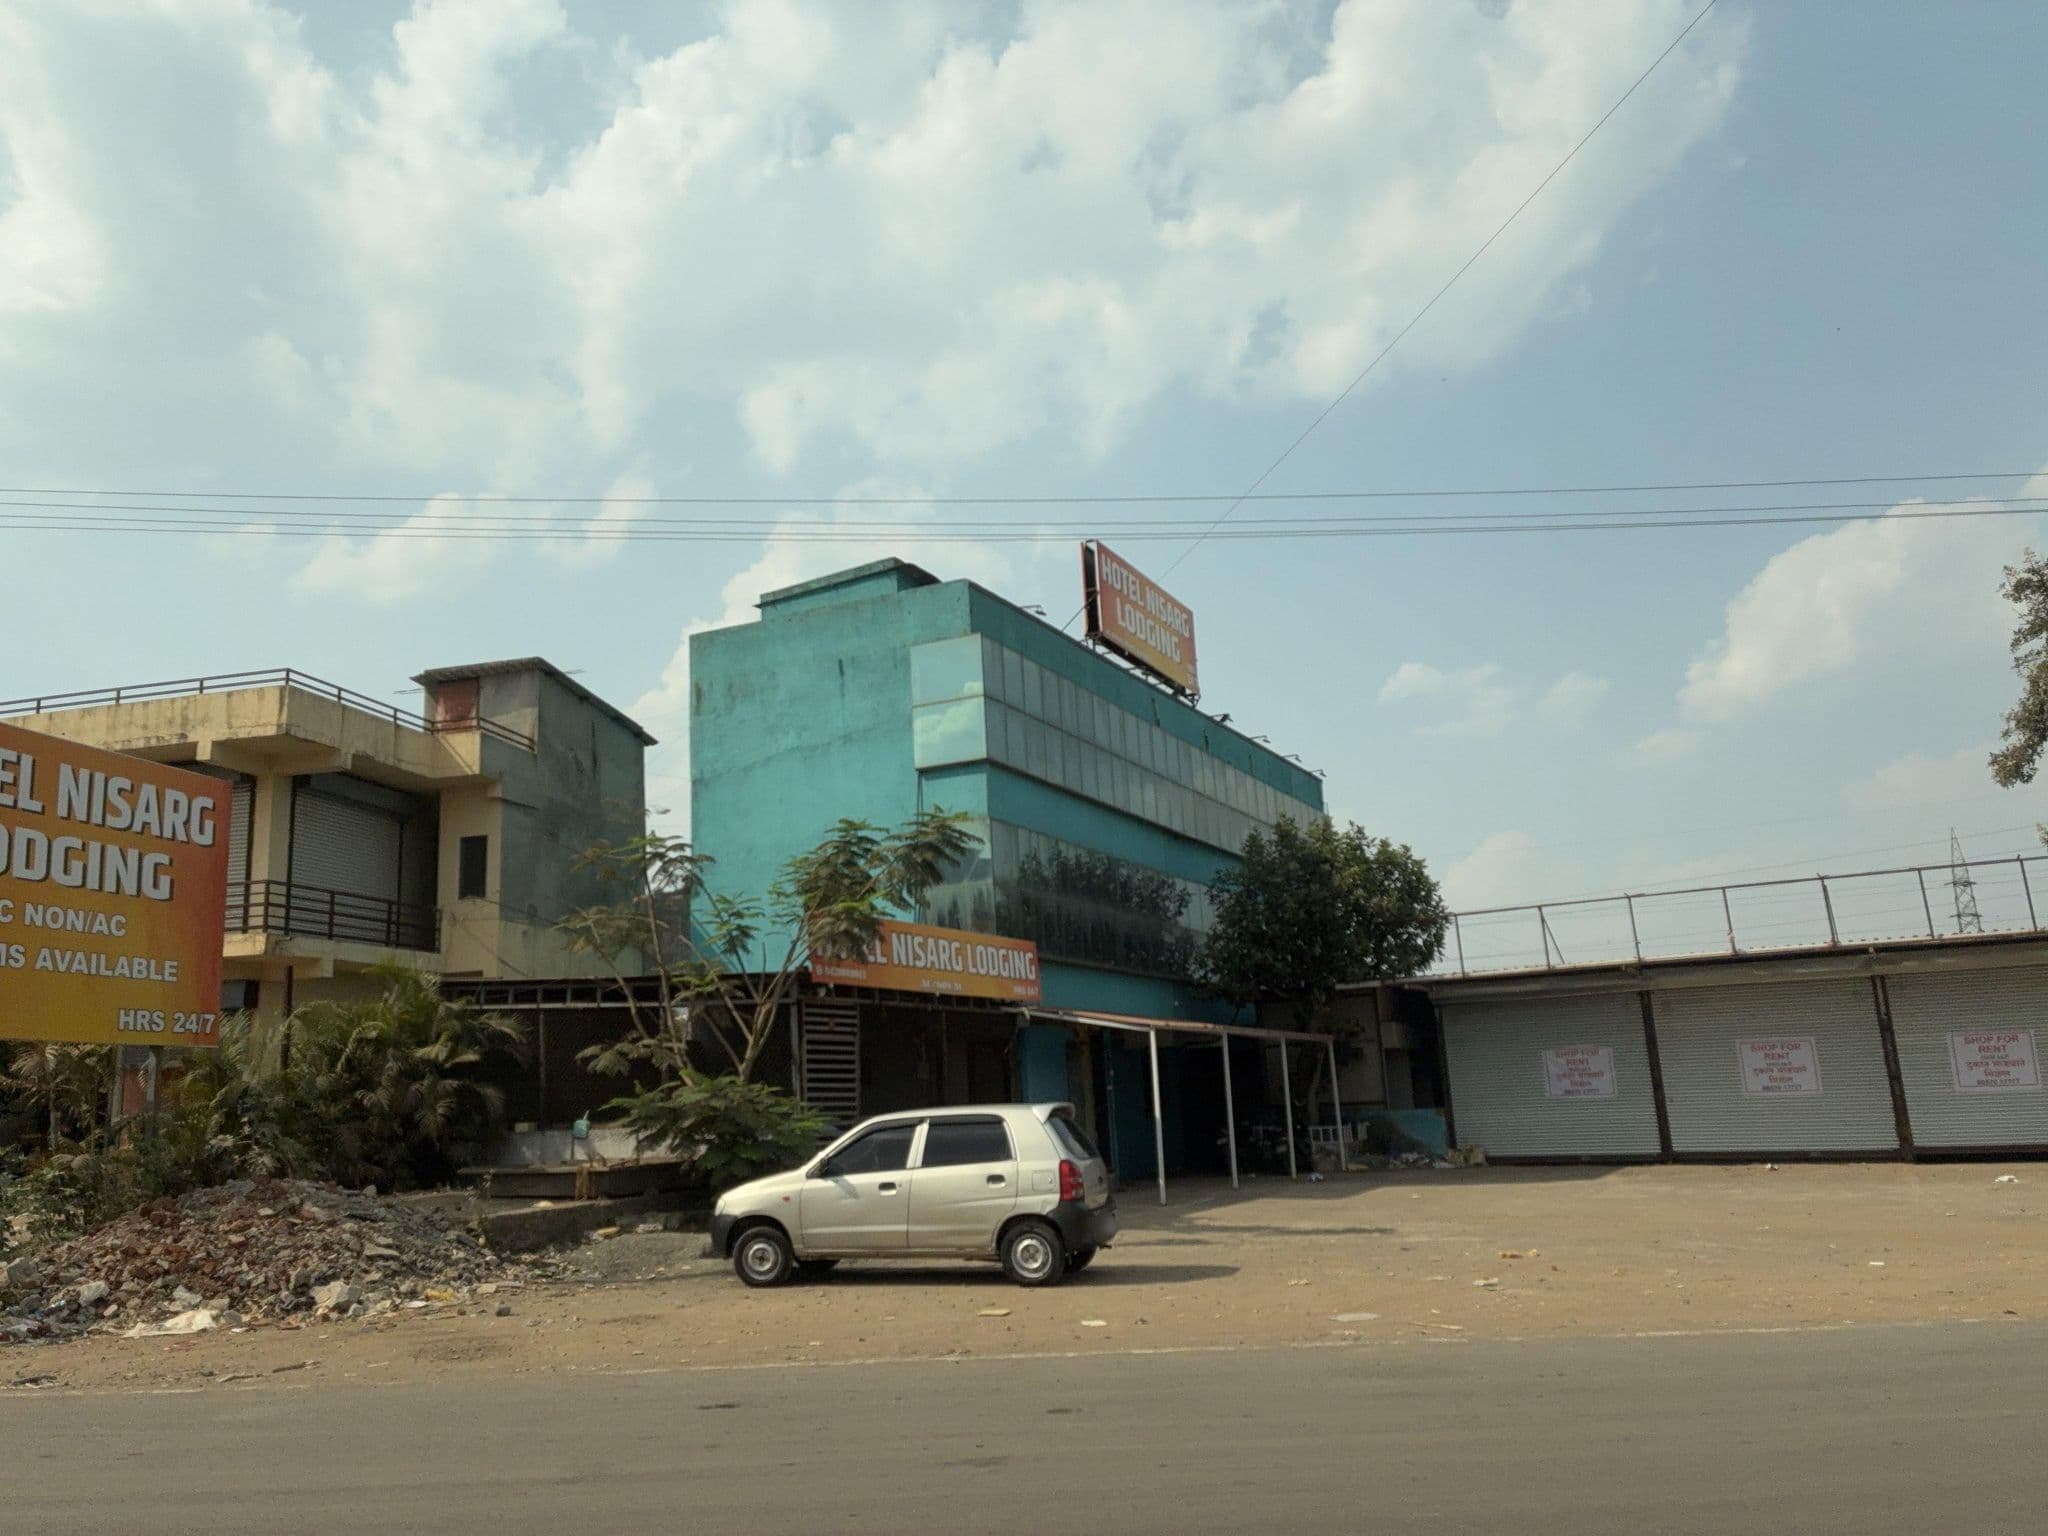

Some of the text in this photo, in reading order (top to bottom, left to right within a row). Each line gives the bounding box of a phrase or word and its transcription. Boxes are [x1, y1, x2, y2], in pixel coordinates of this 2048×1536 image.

[1101, 553, 1190, 638] HOTEL NISARG
[1116, 596, 1182, 664] LODGING
[57, 763, 215, 846] NISARG
[24, 902, 127, 937] NON/AC
[34, 947, 178, 982] AVAILABLE
[891, 932, 964, 972] NISARG
[967, 943, 1036, 981] LODGING
[118, 1008, 216, 1033] HRS 24/7
